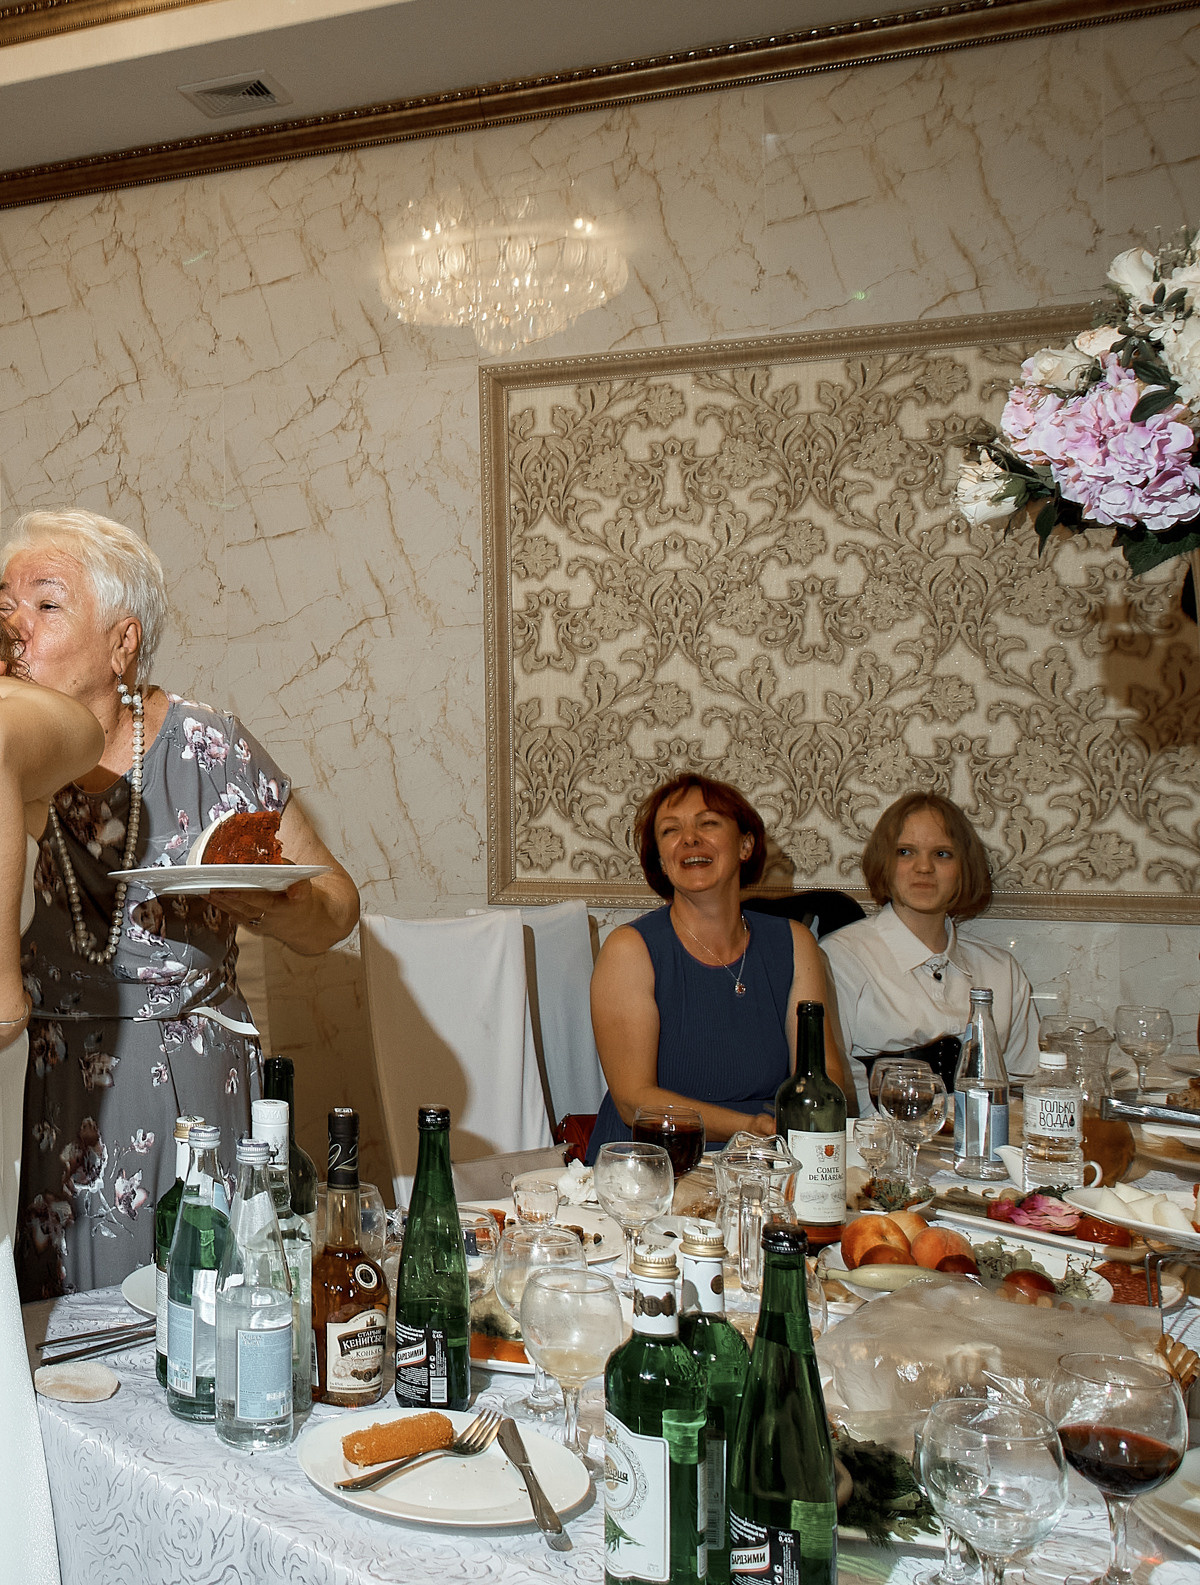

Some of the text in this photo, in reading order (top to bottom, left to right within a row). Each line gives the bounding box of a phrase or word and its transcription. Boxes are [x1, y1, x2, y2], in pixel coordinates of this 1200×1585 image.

[1039, 1098, 1076, 1114] ТОЛЬКО
[1039, 1111, 1070, 1128] ВОДА
[816, 1166, 840, 1174] COMTE
[731, 1552, 766, 1565] БАРДЗИМИ
